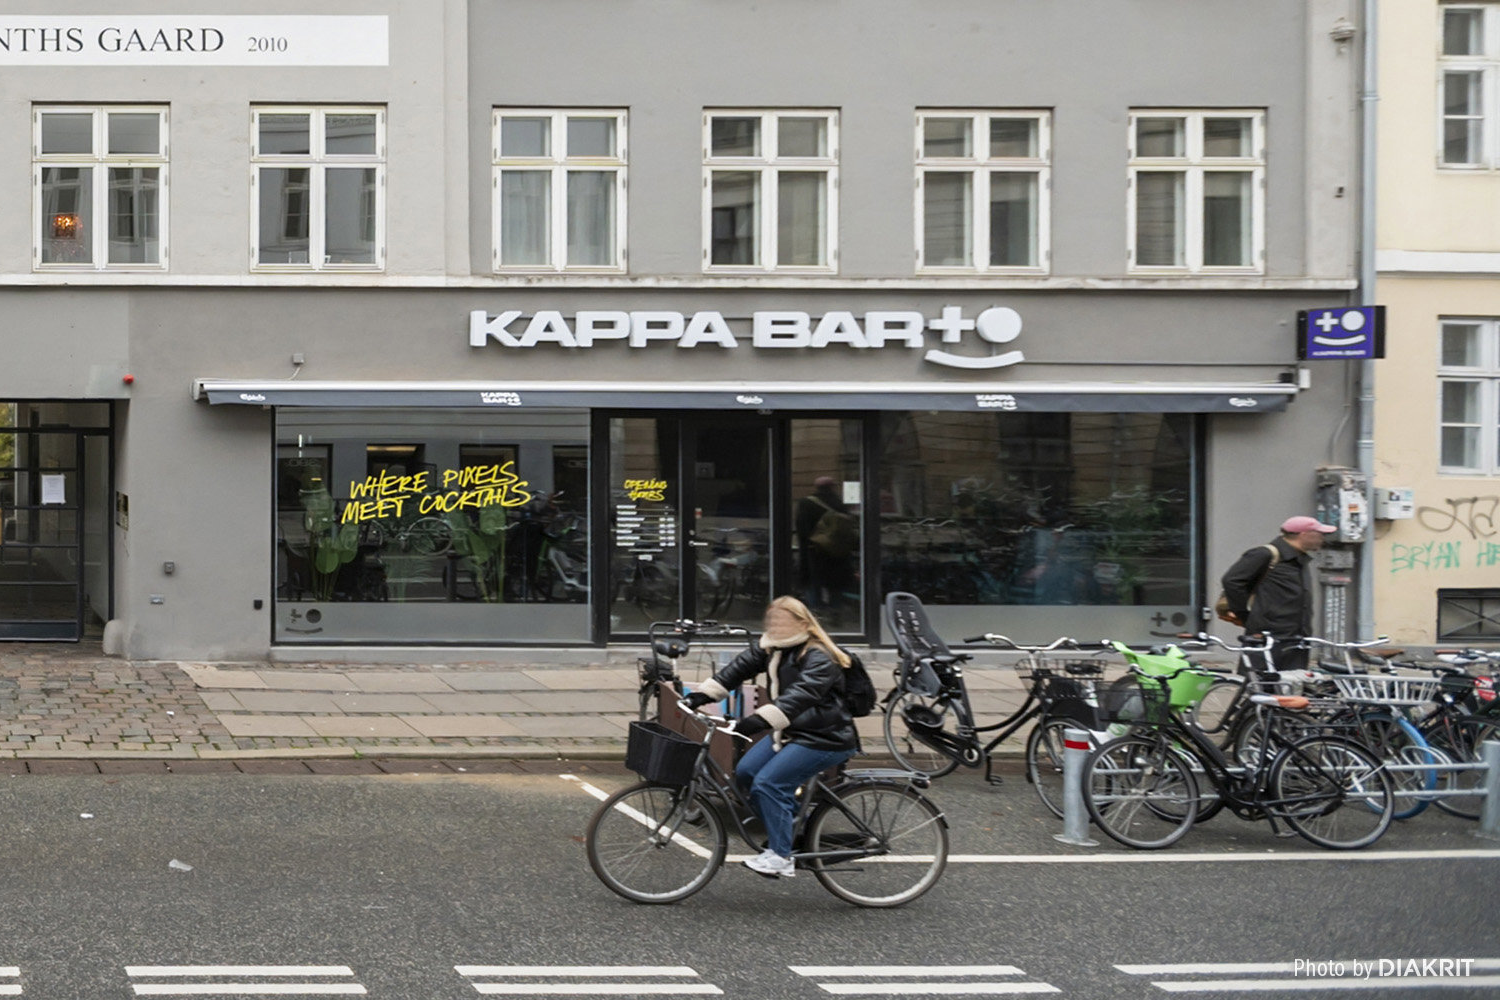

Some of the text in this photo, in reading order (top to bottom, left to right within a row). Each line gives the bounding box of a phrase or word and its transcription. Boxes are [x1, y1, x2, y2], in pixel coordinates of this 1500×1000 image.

[97, 28, 224, 52] GAARD
[247, 37, 288, 52] 2010
[469, 311, 925, 348] KAPPA BAR
[350, 460, 519, 500] WHERE PIXELS
[341, 481, 531, 525] MEET COCKTAILS
